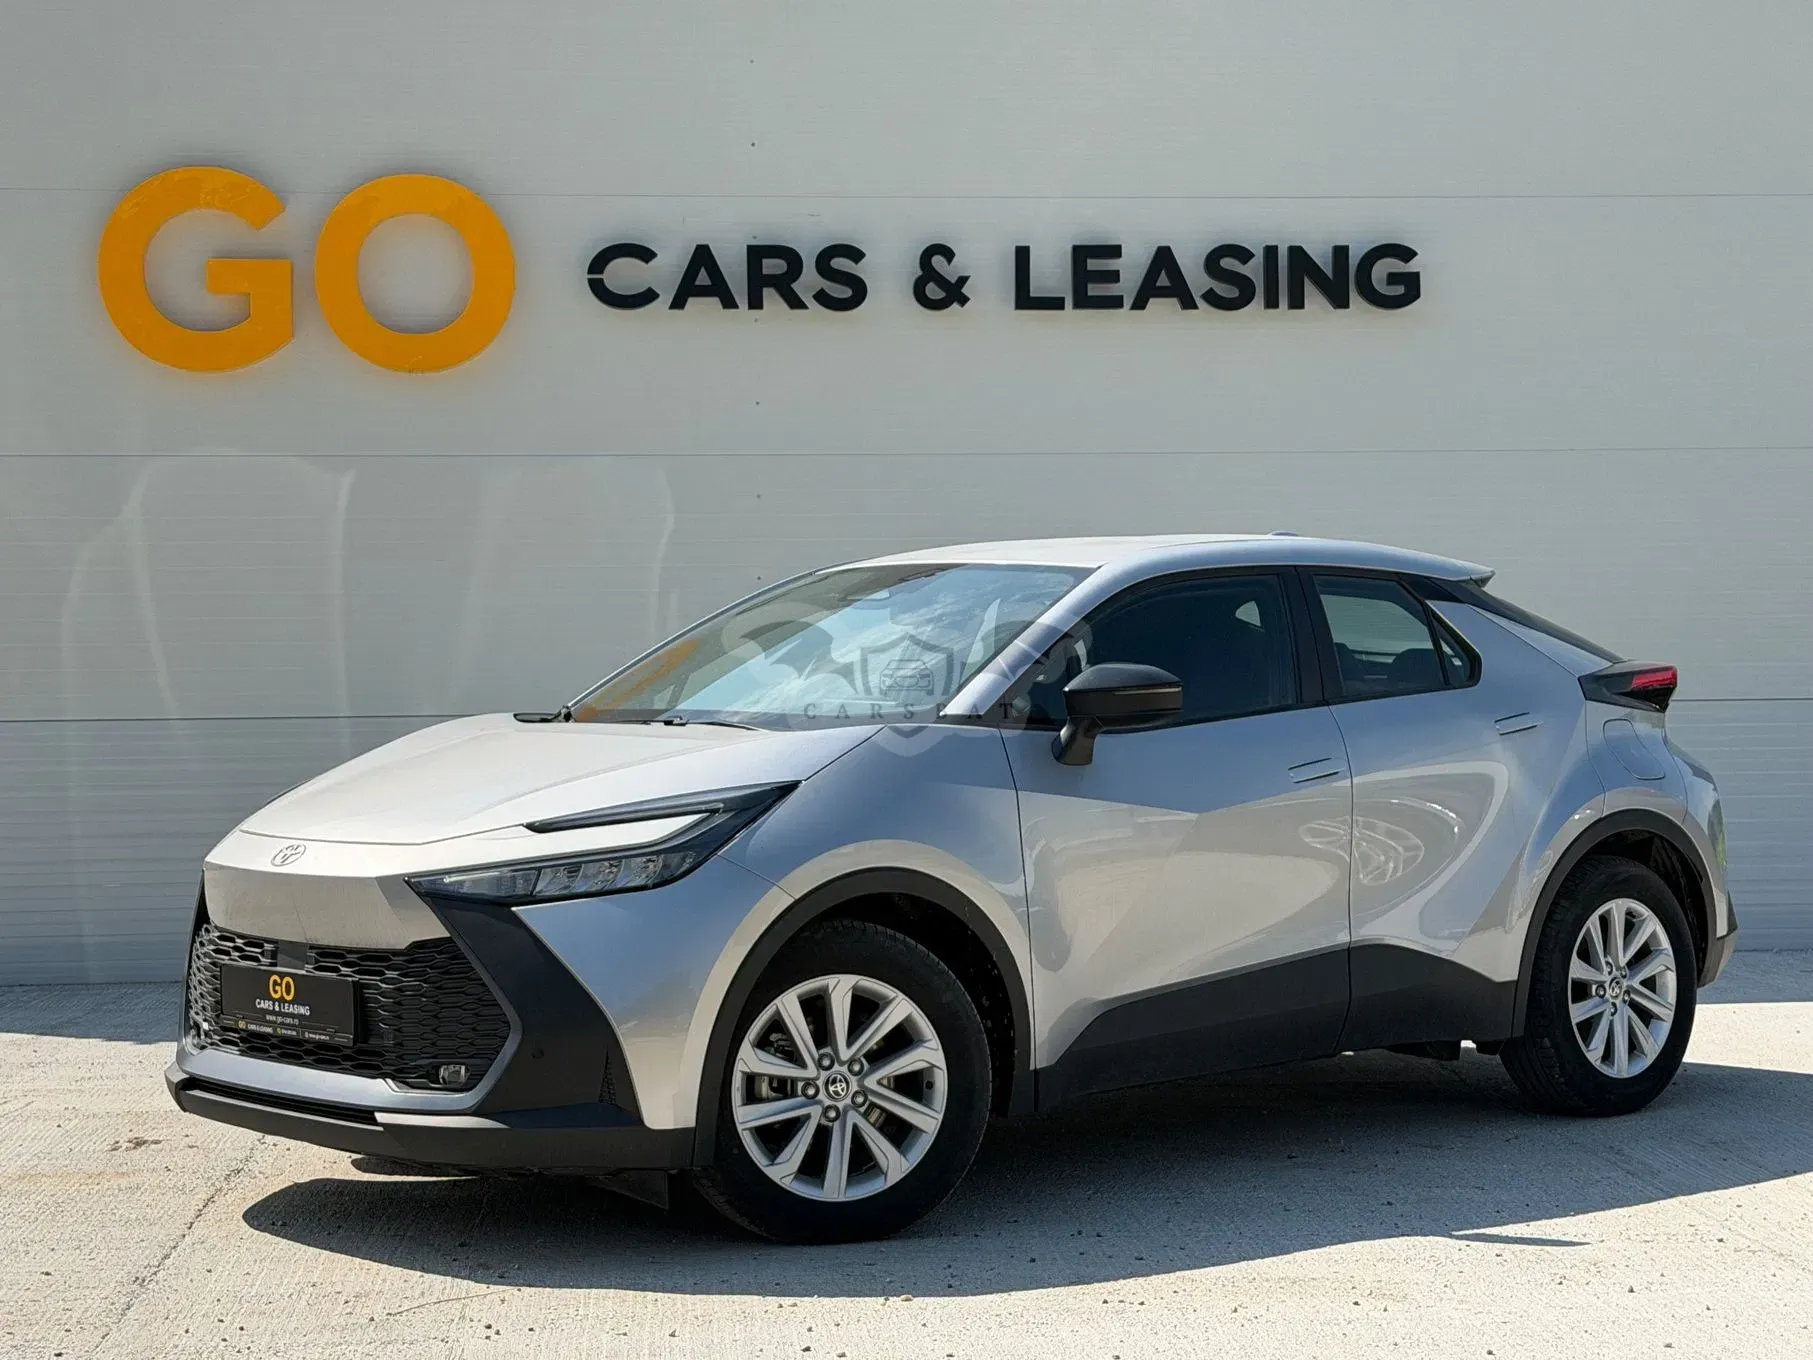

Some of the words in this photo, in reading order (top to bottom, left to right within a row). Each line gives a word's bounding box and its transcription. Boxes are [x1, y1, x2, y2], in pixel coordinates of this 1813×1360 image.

[98, 165, 516, 373] GO
[587, 242, 867, 311] CARS
[913, 243, 971, 311] &
[1014, 242, 1421, 311] LEASING
[269, 974, 295, 1000] GO
[255, 998, 274, 1010] CARS
[274, 1001, 280, 1012] &
[281, 1003, 310, 1015] LEASING
